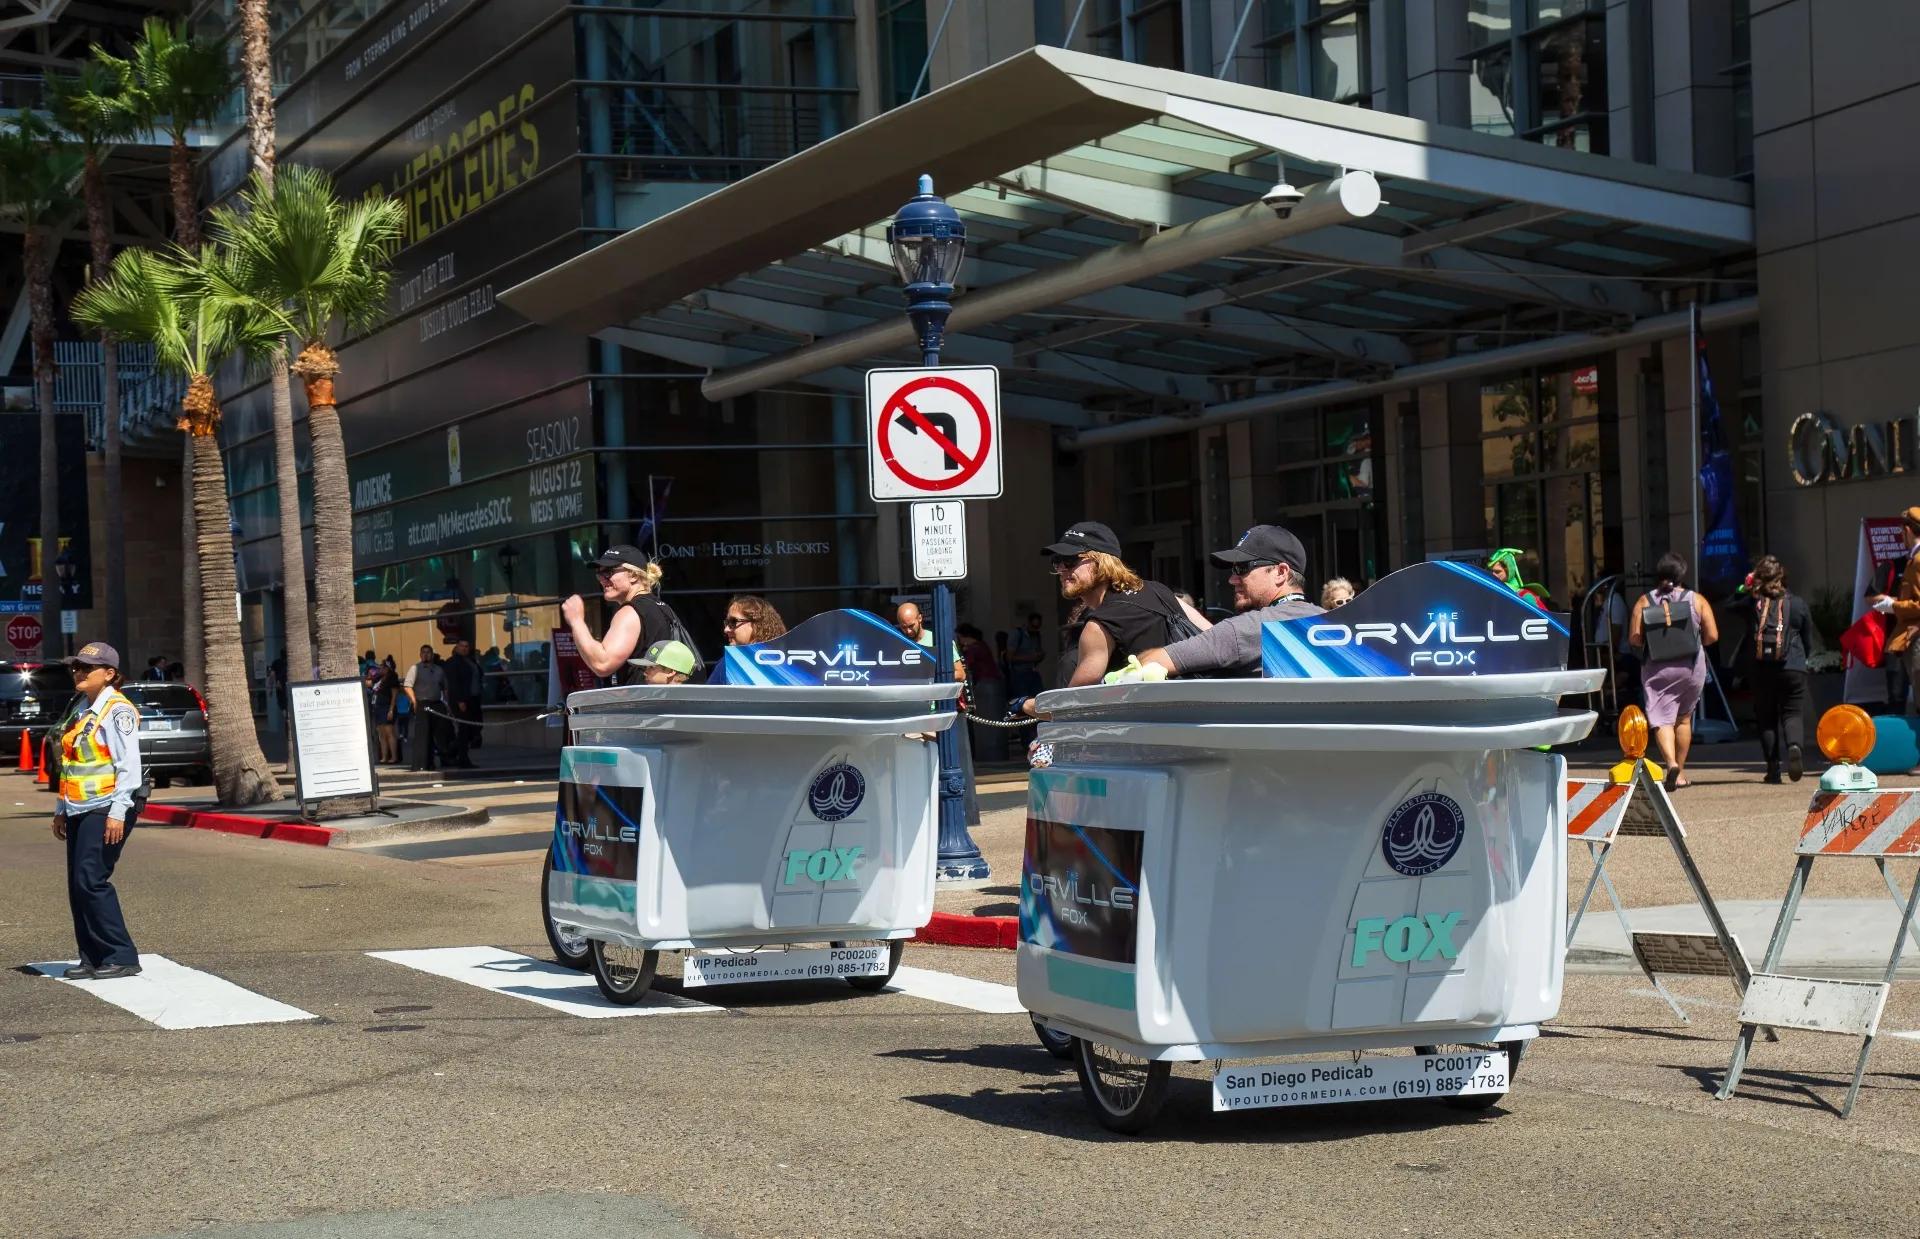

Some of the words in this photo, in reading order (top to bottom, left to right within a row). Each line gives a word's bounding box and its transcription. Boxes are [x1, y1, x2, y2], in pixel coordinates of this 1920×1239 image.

[345, 57, 361, 81] FROM
[364, 33, 390, 67] STEPHEN
[391, 20, 407, 45] KING
[409, 2, 429, 31] DAVID
[400, 275, 421, 311] DON'T
[422, 263, 437, 293] LET
[438, 252, 455, 283] HIM
[420, 306, 446, 342] INSIDE
[447, 296, 469, 328] YOUR
[527, 417, 571, 463] SEASON
[572, 416, 581, 451] 2
[1789, 411, 1904, 486] OMNI
[530, 461, 568, 497] AUGUST
[570, 460, 582, 488] 22
[355, 472, 392, 510] AUDIENCE
[530, 498, 553, 524] WEDS
[556, 494, 577, 520] 10PM
[931, 507, 945, 521] 10
[408, 496, 513, 546] att.com/MrMercedesSDCC
[924, 525, 953, 535] MINUTE
[659, 543, 695, 558] OMNI
[712, 541, 761, 557] HOTELS
[762, 543, 773, 555] &
[776, 540, 830, 555] RESORTS
[922, 538, 957, 546] PASSENGER
[927, 547, 953, 556] LOADING
[743, 557, 771, 567] diego
[22, 584, 80, 594] HISY
[1428, 612, 1459, 620] THE
[8, 626, 41, 640] STOP
[1307, 618, 1549, 646] ORVILLE
[754, 649, 922, 666] ORVILLE
[1410, 650, 1476, 666] FOX
[824, 670, 870, 681] FOX
[299, 700, 315, 709] valet
[316, 698, 342, 709] parking
[813, 764, 849, 786] PLANETARY
[850, 766, 865, 786] UNION
[1387, 794, 1439, 828] PLANETARY
[1441, 796, 1464, 822] UNION
[562, 820, 637, 843] ORVILLE
[583, 843, 603, 856] FOX
[785, 846, 864, 885] FOX
[1395, 861, 1442, 876] ORVILLE
[1066, 870, 1079, 880] THE
[1030, 873, 1134, 910] ORVILLE
[1061, 907, 1088, 926] FOX
[1352, 911, 1464, 967] FOX
[693, 959, 711, 969] VIP
[714, 956, 758, 968] Pedicab
[830, 950, 878, 961] PC00206
[687, 968, 804, 981] VIPOUTDOORMEDIA.COM
[807, 964, 835, 978] (619)
[837, 961, 886, 974] 885-1782
[1424, 1055, 1492, 1073] PC00175
[1226, 1075, 1256, 1090] San
[1261, 1070, 1307, 1089] Diego
[1311, 1064, 1374, 1083] Pedicab
[1393, 1079, 1431, 1098] (619)
[1436, 1074, 1505, 1092] 885-1782
[1219, 1084, 1388, 1107] VIPOUTDOORMEDIA.COM
